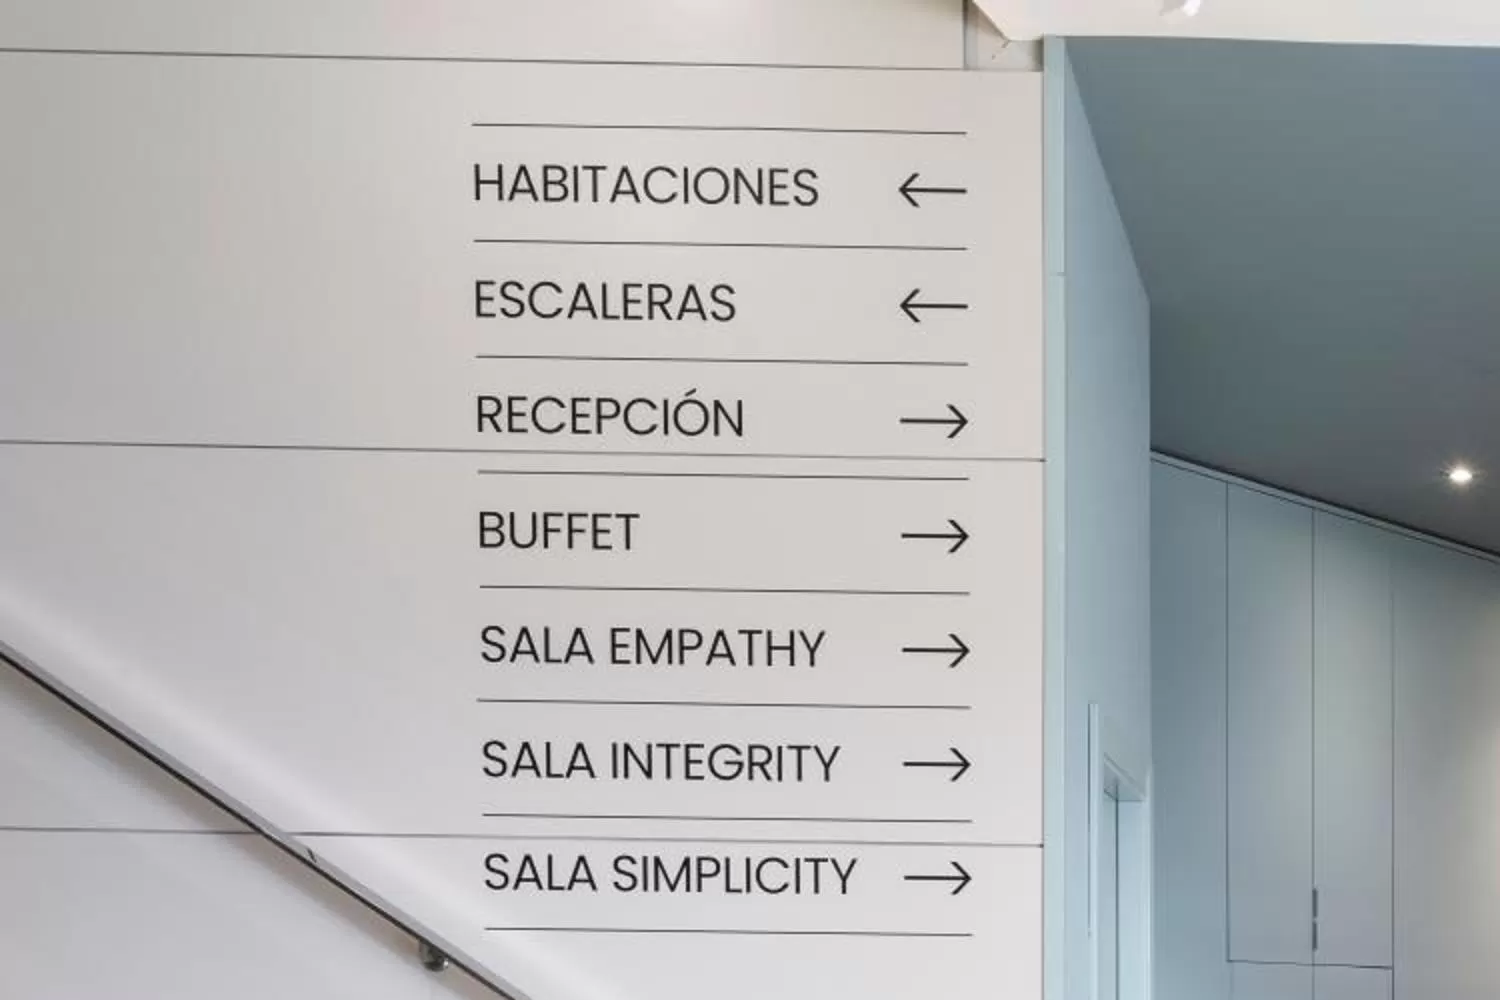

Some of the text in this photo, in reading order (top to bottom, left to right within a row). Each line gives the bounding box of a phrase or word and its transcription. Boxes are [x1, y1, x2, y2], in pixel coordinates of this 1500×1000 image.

[474, 163, 819, 207] HABITACIONES
[475, 280, 736, 322] ESCALERAS
[477, 388, 744, 437] RECEPCIÓN
[479, 511, 640, 551] BUFFET
[481, 625, 825, 667] SALA EMPATHY
[482, 740, 841, 782] SALA INTEGRITY
[484, 853, 857, 895] SALA SIMPLICITY
